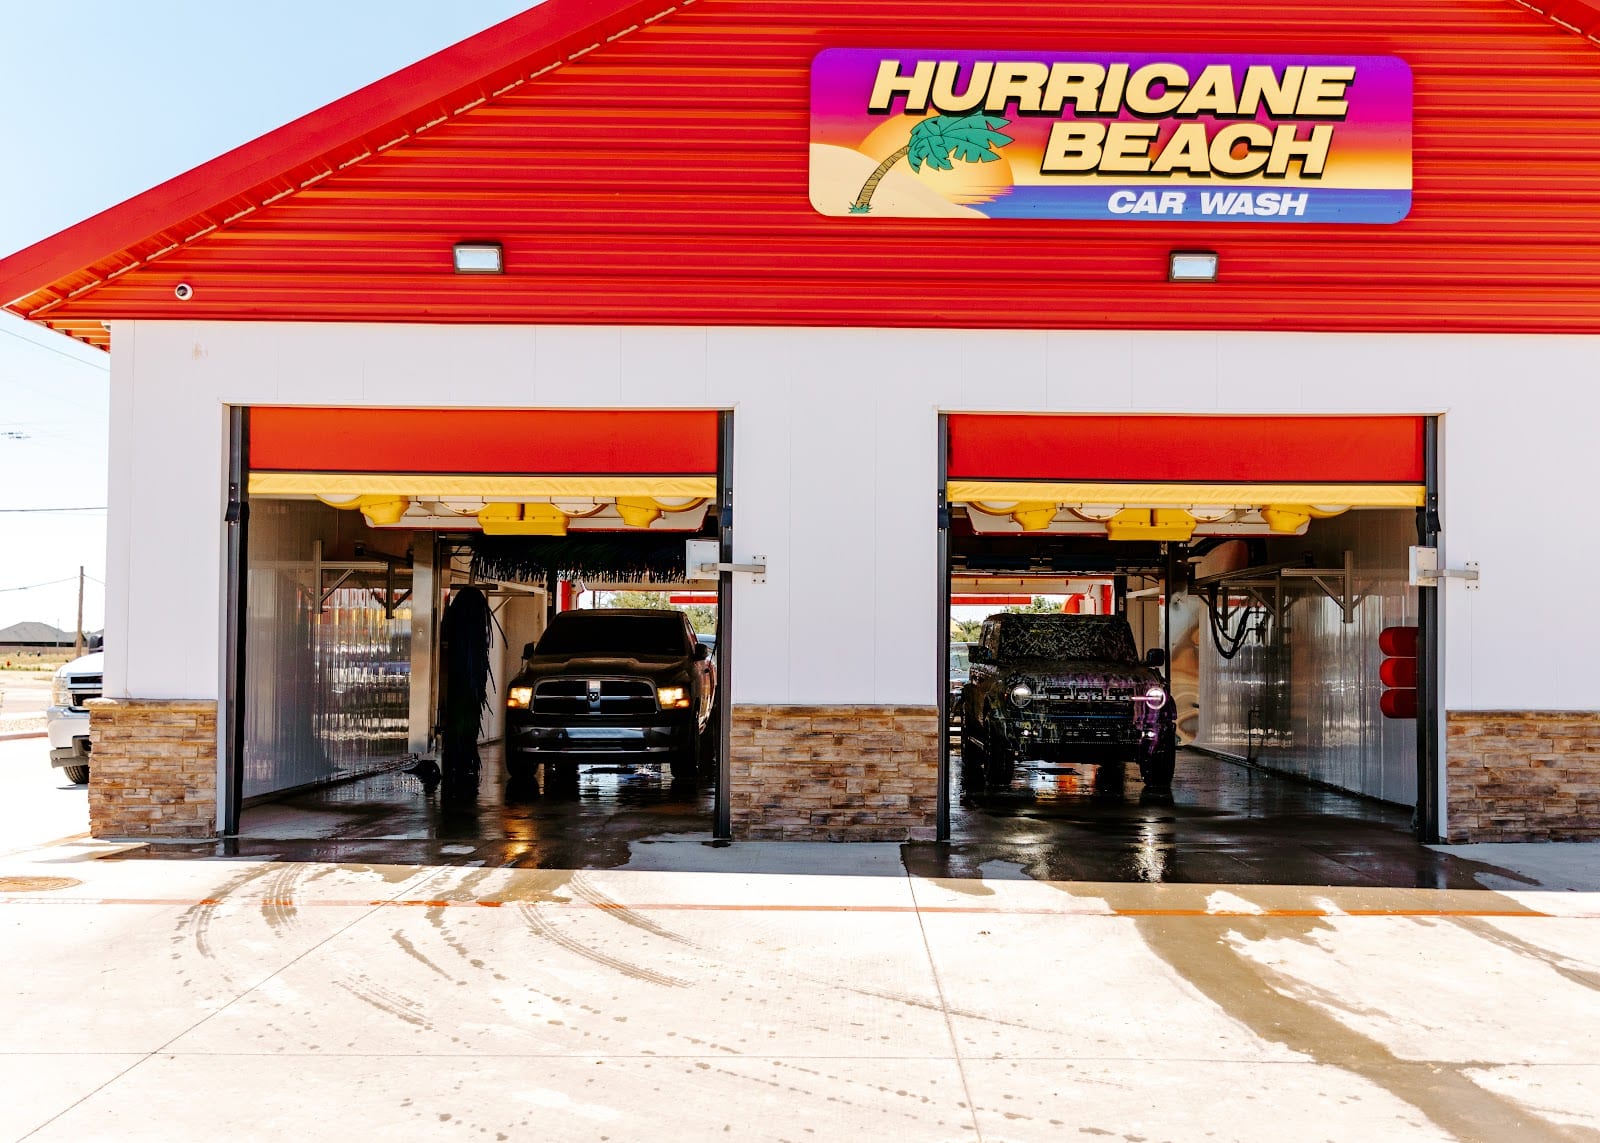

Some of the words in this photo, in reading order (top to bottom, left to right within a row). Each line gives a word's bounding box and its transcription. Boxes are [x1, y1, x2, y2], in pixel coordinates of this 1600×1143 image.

[868, 60, 1356, 117] HURRICANE
[1041, 122, 1333, 178] BEACH
[1107, 190, 1186, 214] CAR
[1200, 192, 1308, 216] WASH
[1049, 693, 1130, 701] BRONCO
